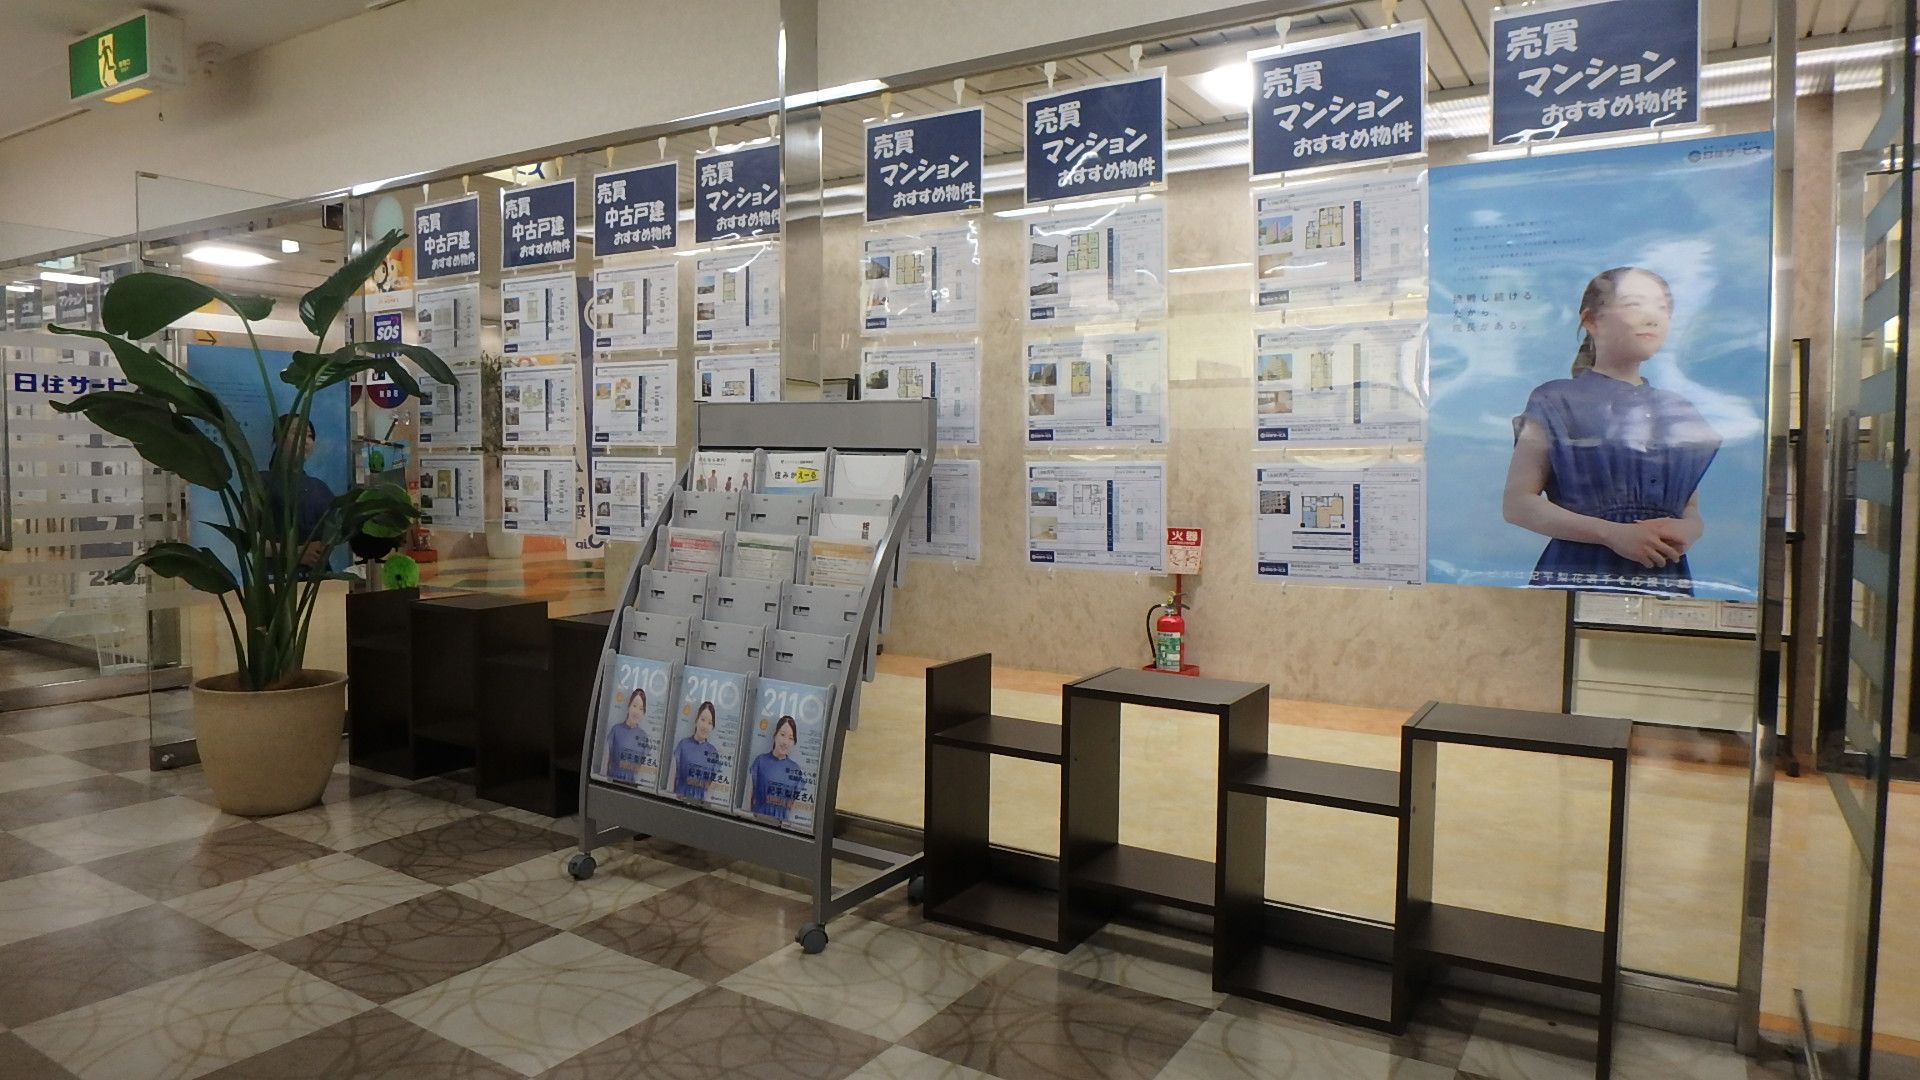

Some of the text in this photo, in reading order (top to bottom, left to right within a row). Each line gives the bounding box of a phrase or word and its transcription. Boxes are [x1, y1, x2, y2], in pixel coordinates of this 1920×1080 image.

[1507, 18, 1579, 62] 売買
[1263, 60, 1323, 99] 売買
[1518, 50, 1677, 98] マンション
[1034, 101, 1082, 136] 売買
[1273, 89, 1404, 132] マンション
[1541, 86, 1688, 126] おすすめ物件
[873, 129, 915, 160] 売買
[1042, 127, 1148, 164] マンション
[1293, 121, 1413, 157] おすすめ物件
[701, 160, 734, 187] 売買
[880, 154, 970, 187] マンション
[1057, 156, 1156, 188] おすすめ物件
[597, 180, 627, 204] 売買
[706, 183, 778, 212] マンション
[893, 181, 976, 209] おすすめ物件
[505, 197, 531, 219] 売買
[605, 200, 665, 228] 中古戸建
[716, 209, 780, 231] おすすめ物件
[418, 212, 441, 235] 売買
[512, 215, 565, 242] 中古戸建
[613, 225, 672, 245] おすすめ物件
[424, 230, 470, 255] 中古戸建
[519, 238, 571, 259] おすすめ物件
[431, 252, 476, 270] おすすめ物件
[376, 325, 400, 341] SOS
[619, 663, 669, 697] 2110
[684, 675, 740, 709] 2110
[760, 688, 825, 725] 2110
